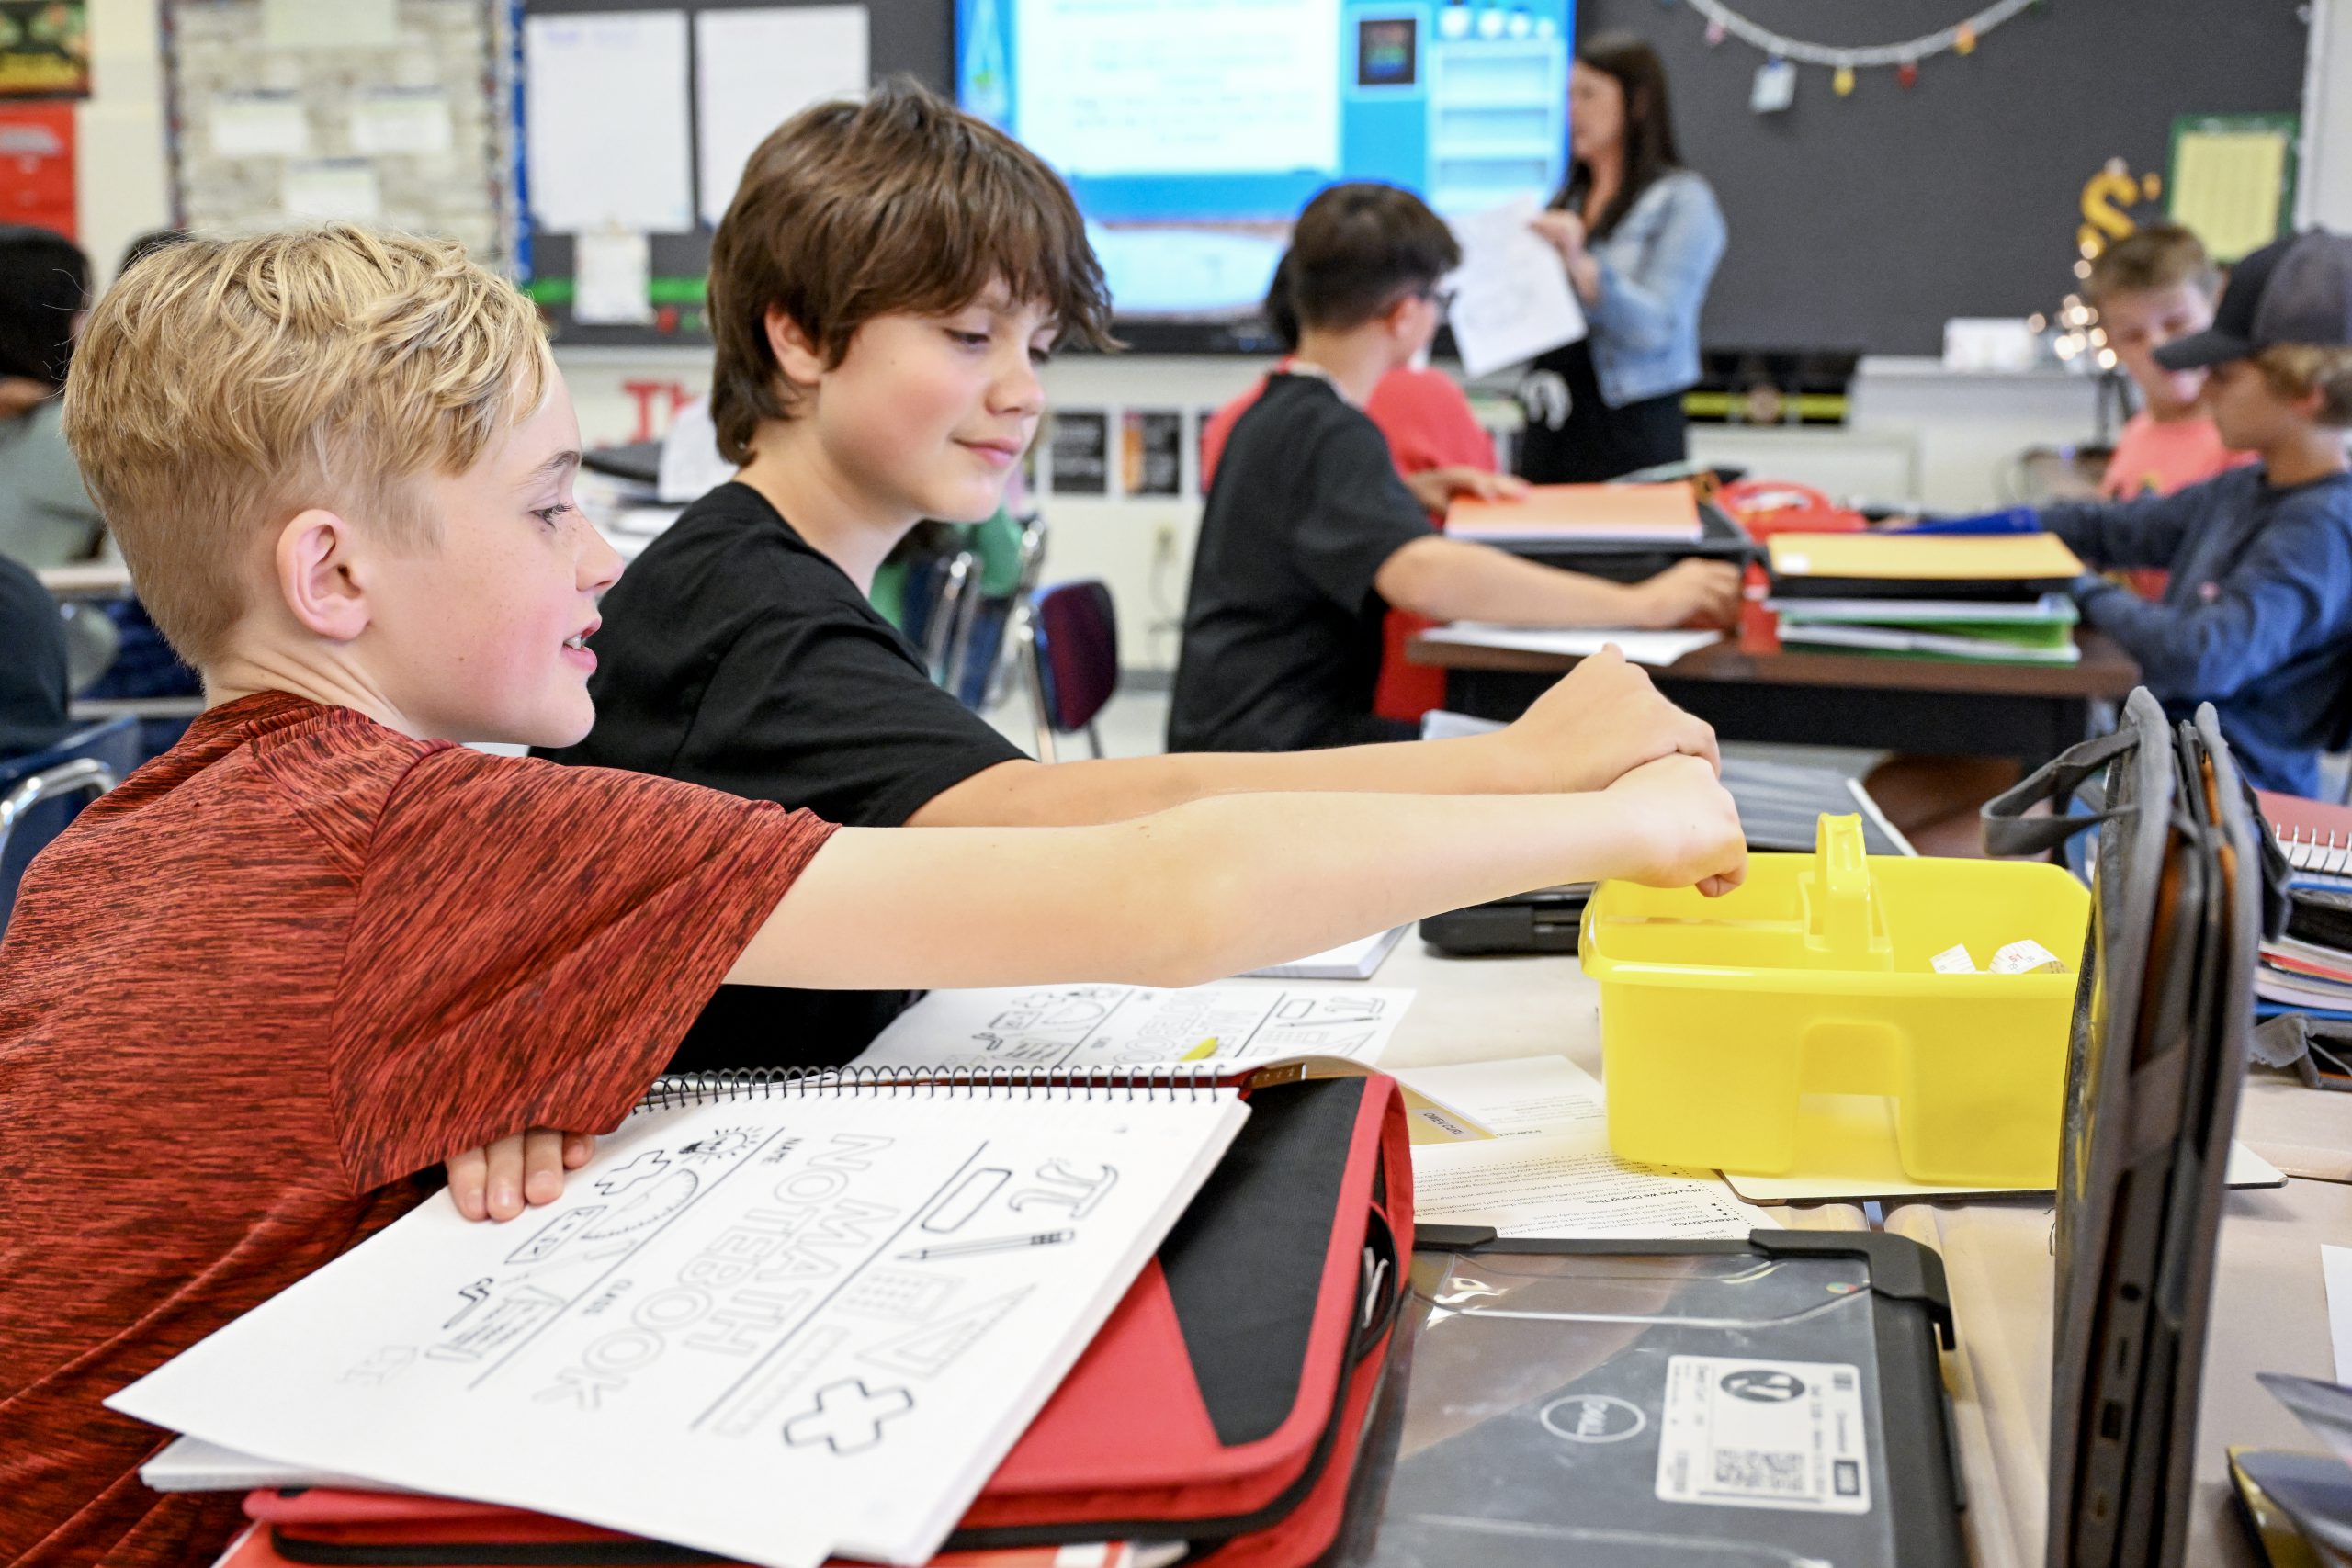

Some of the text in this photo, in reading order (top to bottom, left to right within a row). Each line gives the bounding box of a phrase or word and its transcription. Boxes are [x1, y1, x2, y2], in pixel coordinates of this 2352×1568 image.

[761, 1136, 805, 1166] NAME
[531, 1133, 896, 1411] NOTEBOOK
[682, 1197, 901, 1357] MATH
